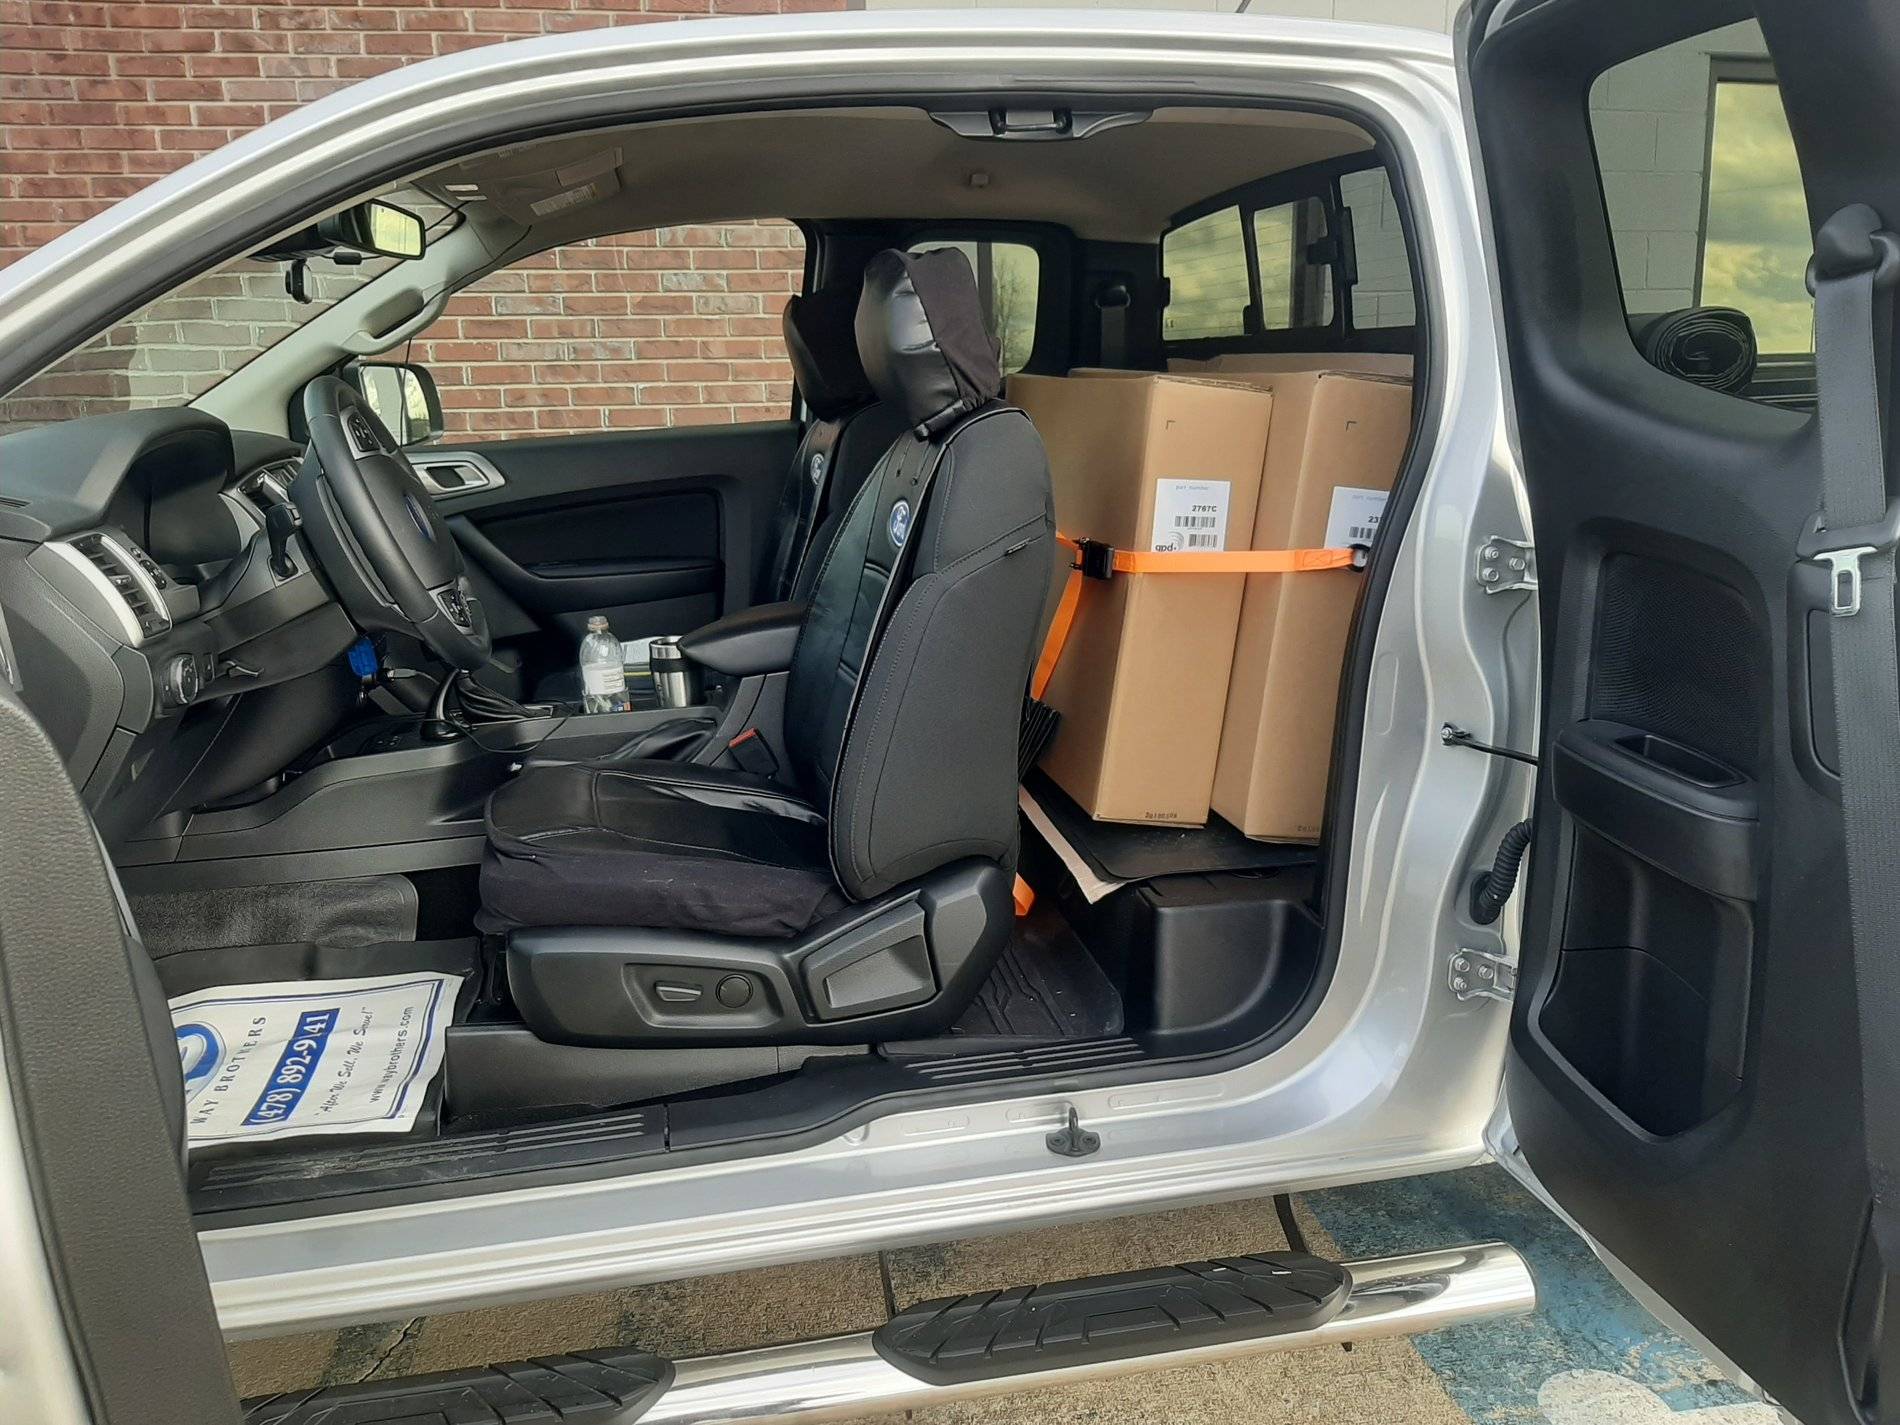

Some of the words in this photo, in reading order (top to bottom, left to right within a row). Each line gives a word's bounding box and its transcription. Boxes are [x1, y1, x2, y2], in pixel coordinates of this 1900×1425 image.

[190, 1099, 219, 1124] WAY
[213, 1016, 267, 1092] BROTHERS
[249, 1087, 302, 1123] (478)
[276, 1013, 331, 1084] 892-9141
